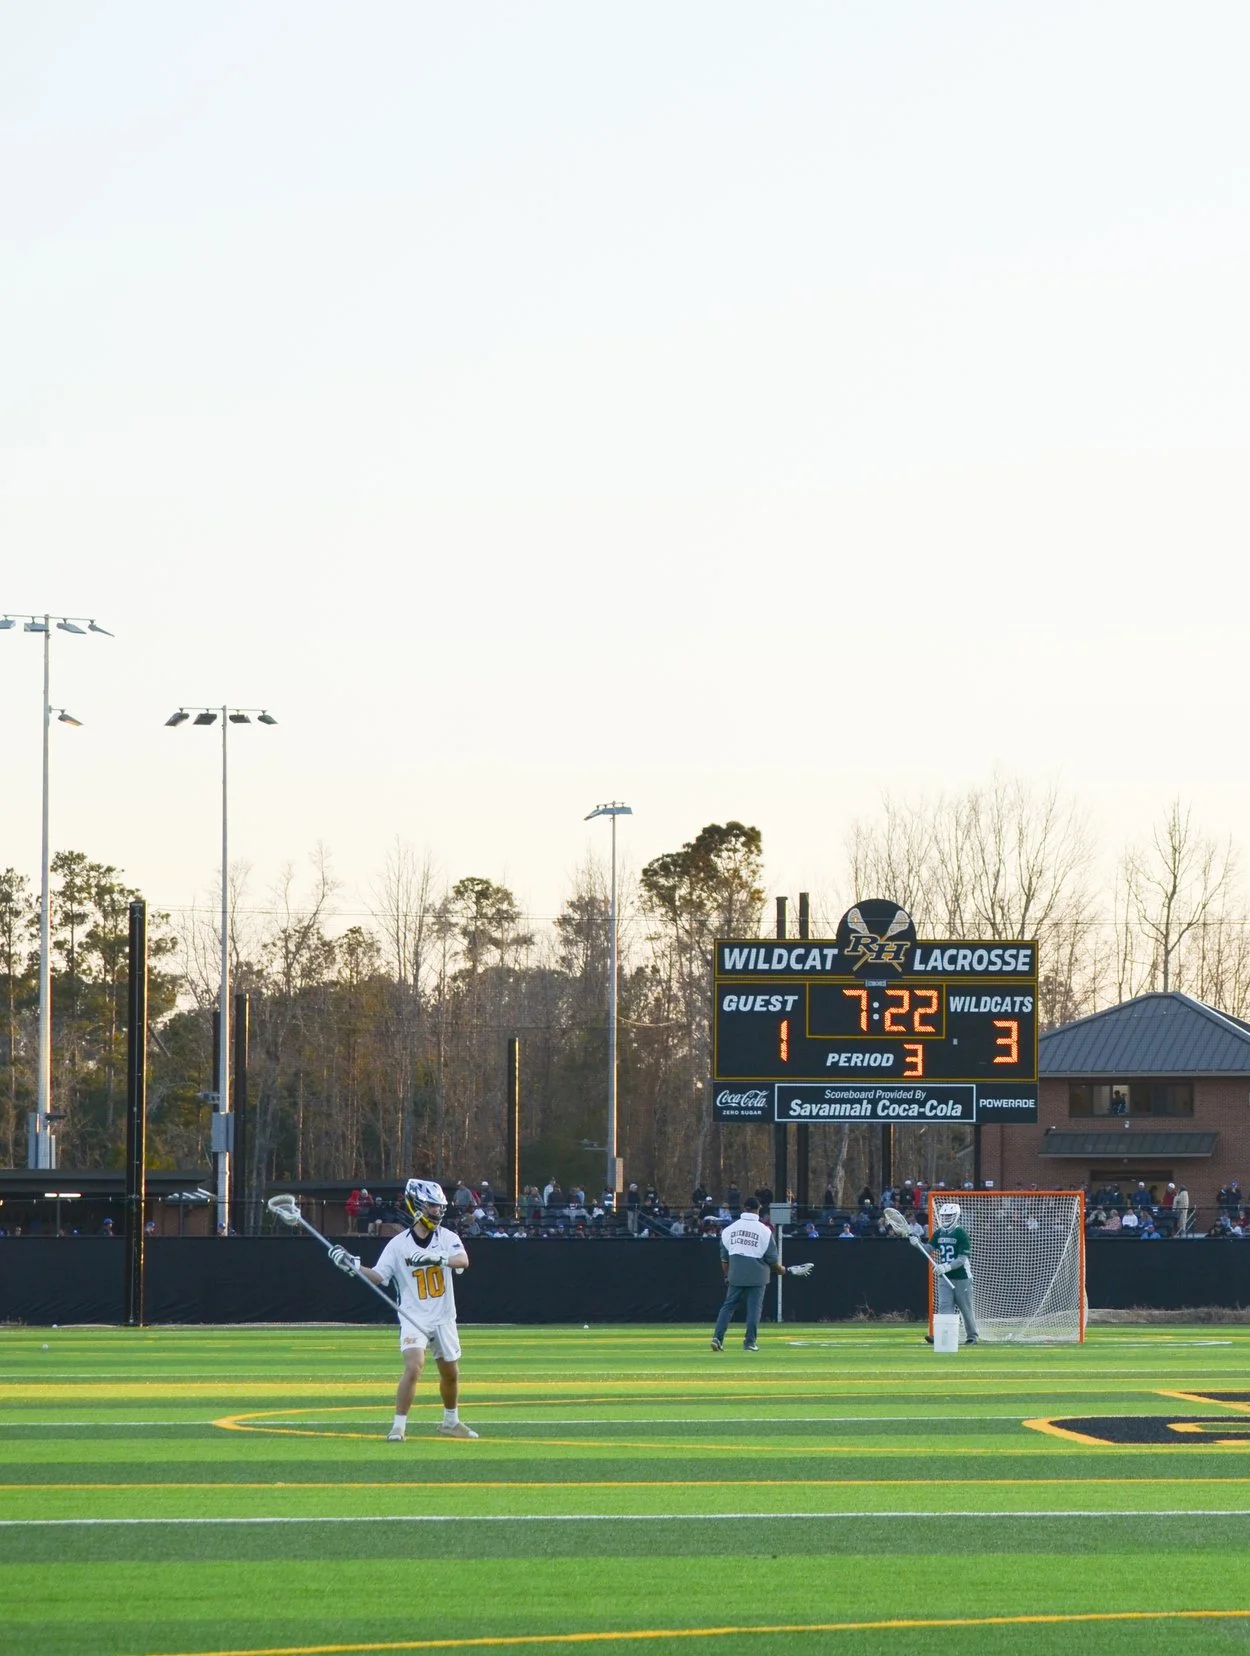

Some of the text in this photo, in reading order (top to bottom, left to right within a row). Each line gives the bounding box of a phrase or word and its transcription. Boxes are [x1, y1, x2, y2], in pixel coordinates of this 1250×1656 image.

[723, 947, 838, 970] WILDCAT
[844, 933, 911, 963] RH
[912, 948, 1032, 971] LACROSSE
[722, 995, 798, 1012] GUEST
[842, 989, 938, 1033] 7:22
[949, 996, 1034, 1013] WILDCATS
[779, 1019, 789, 1062] 1
[992, 1020, 1019, 1063] 3
[826, 1052, 895, 1067] PERIOD
[903, 1043, 923, 1076] 3
[716, 1089, 769, 1108] Coca-Cola
[824, 1089, 927, 1101] Scoreboard Provided By
[979, 1099, 1035, 1108] POWERADE
[788, 1098, 962, 1117] Savannah Coca-Cola
[411, 1265, 446, 1300] 10
